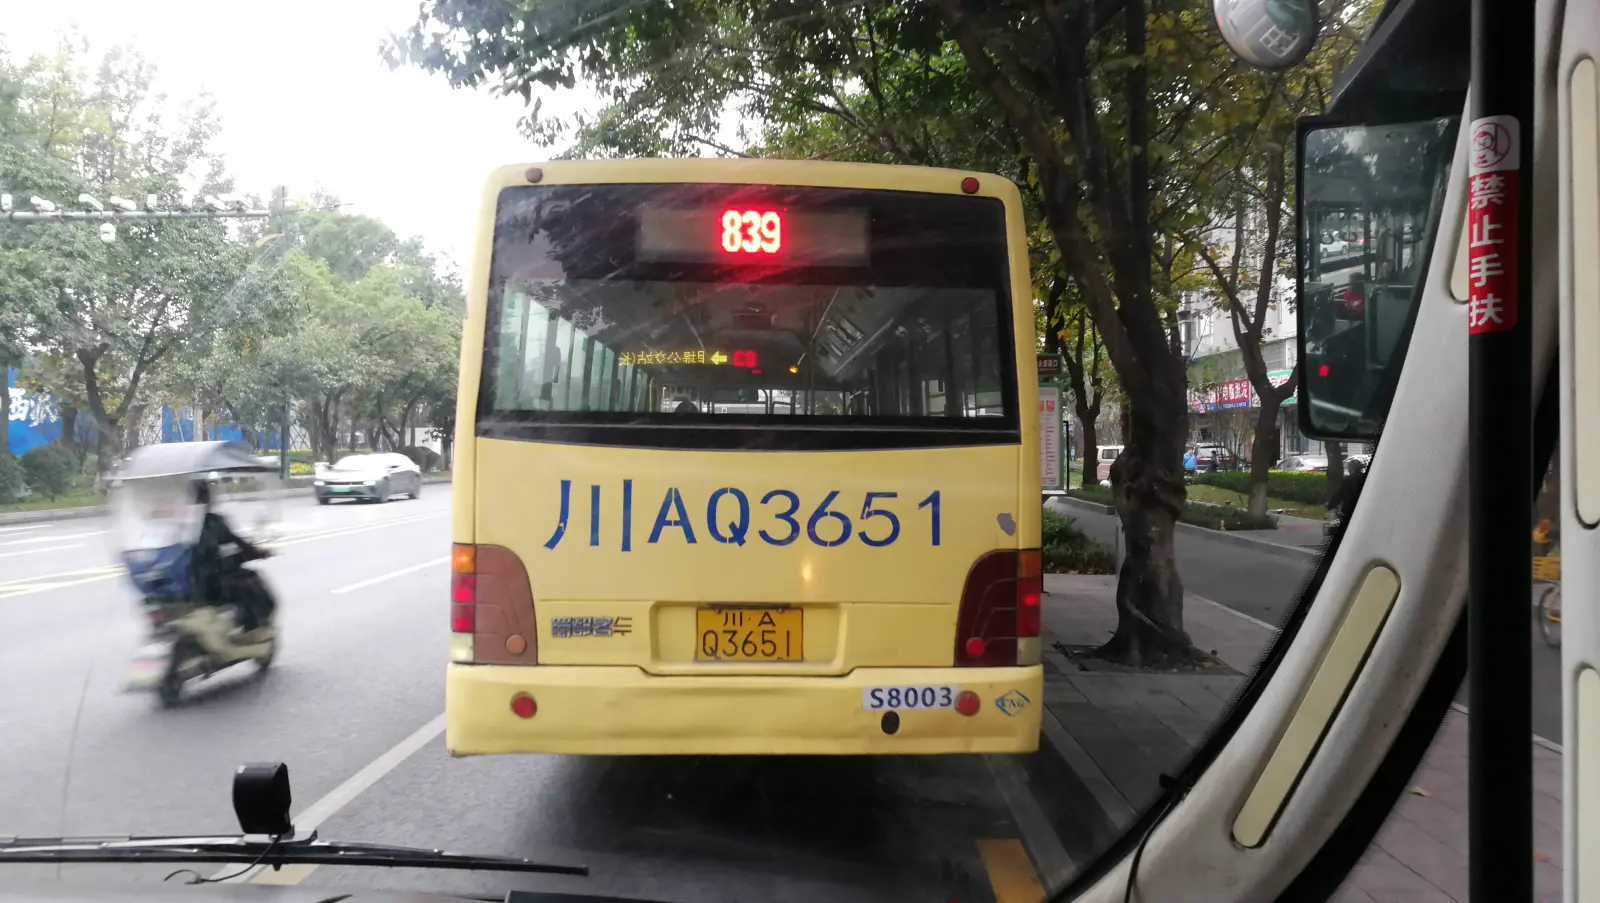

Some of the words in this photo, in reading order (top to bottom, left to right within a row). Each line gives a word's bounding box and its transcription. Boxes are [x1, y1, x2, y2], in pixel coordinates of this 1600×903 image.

[721, 209, 781, 253] 839
[1469, 175, 1505, 327] 禁止手扶
[544, 478, 942, 553] 川AQ3651
[702, 630, 791, 658] Q3651
[870, 686, 953, 709] S8003
